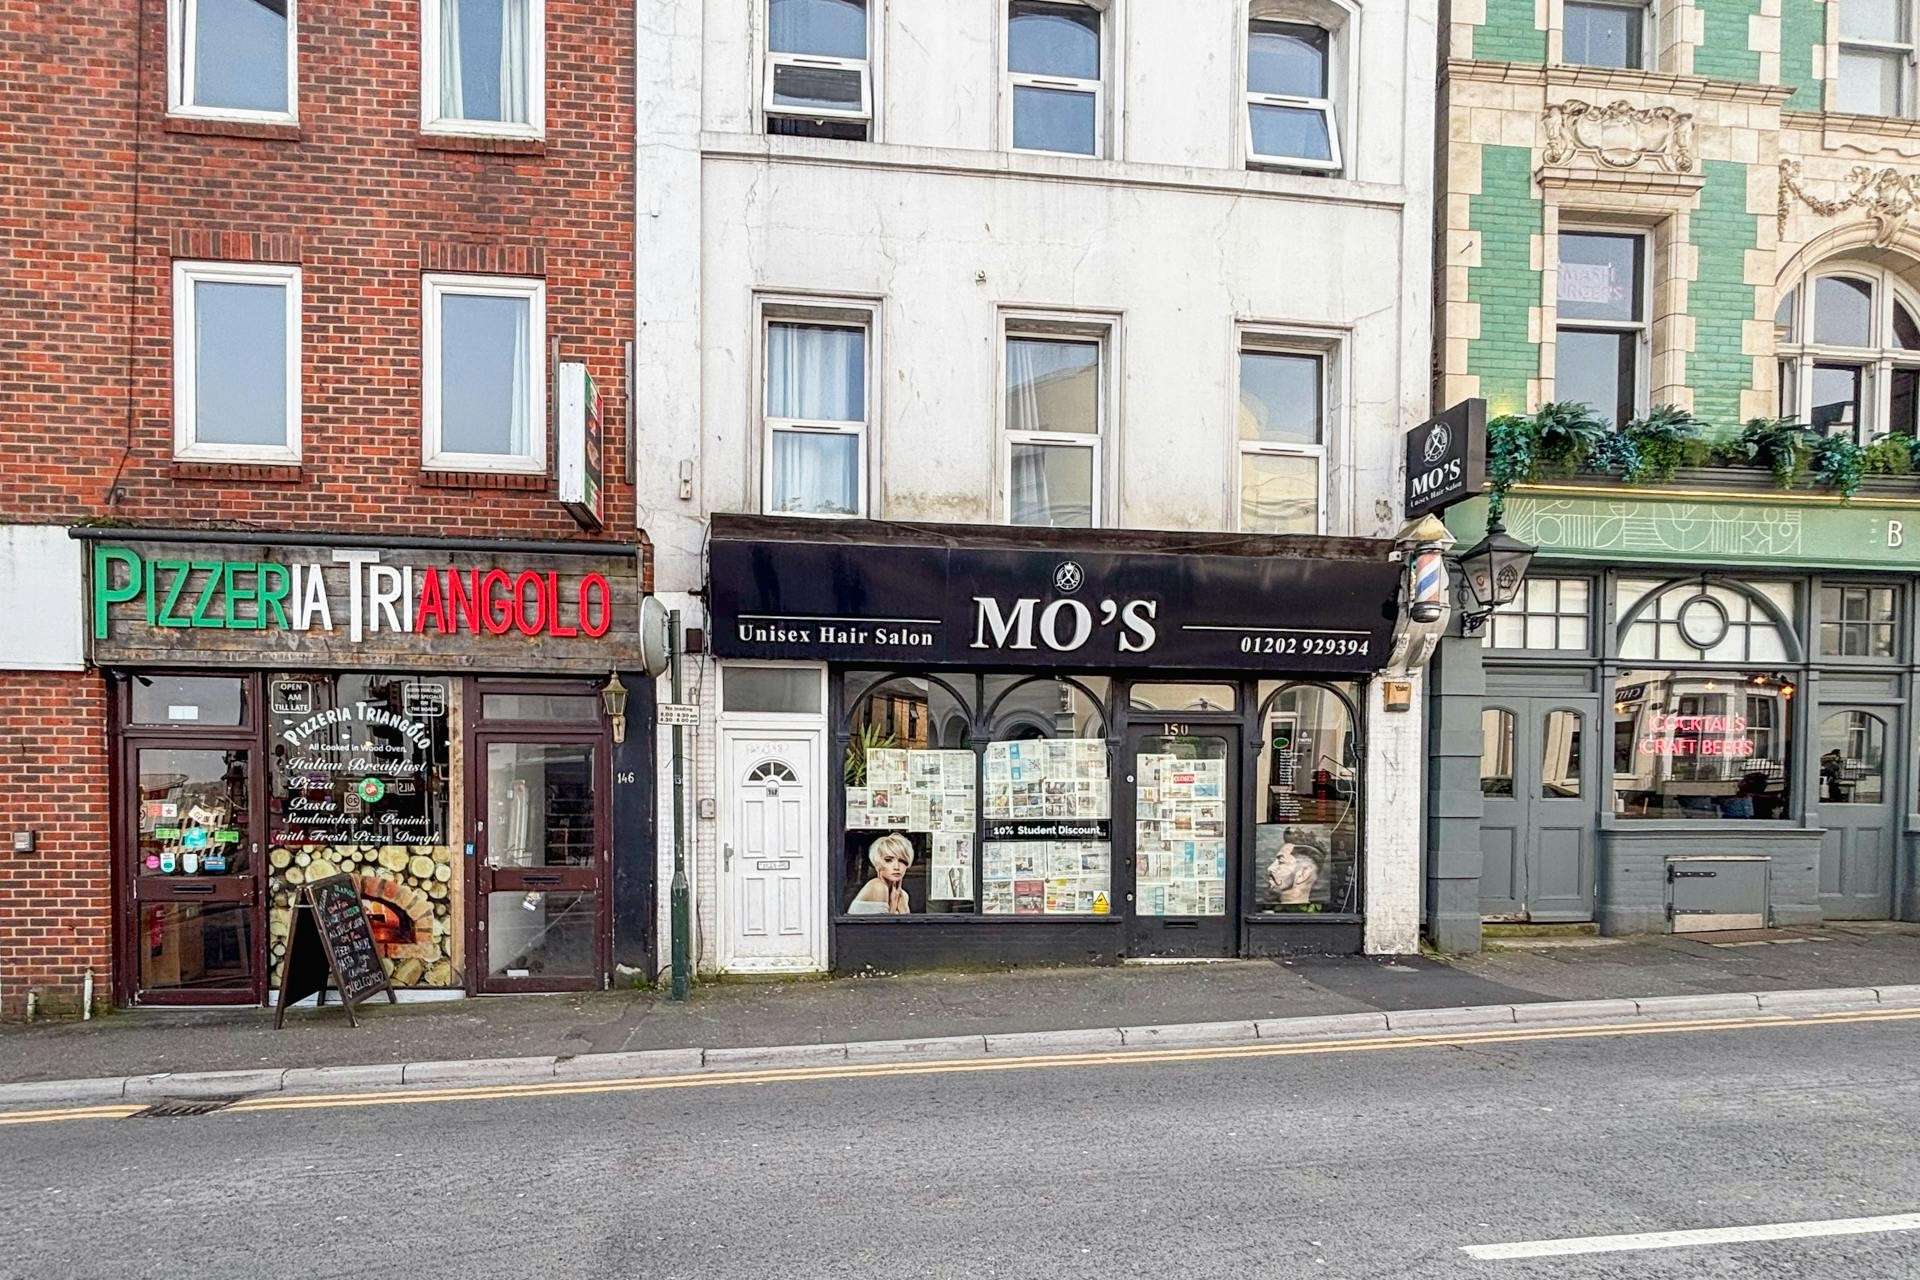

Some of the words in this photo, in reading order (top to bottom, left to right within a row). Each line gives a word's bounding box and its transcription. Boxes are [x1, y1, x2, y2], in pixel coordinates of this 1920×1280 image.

[1411, 458, 1461, 498] MO'S
[1887, 520, 1903, 547] B
[95, 546, 333, 639] PIZZERIA
[332, 550, 611, 642] TRIANGOLO
[970, 597, 1157, 652] MO'S
[738, 624, 810, 642] Unisex
[819, 626, 869, 644] Hair
[875, 628, 933, 645] Salon
[1240, 637, 1296, 654] 01202
[1302, 637, 1369, 656] 929394
[280, 683, 302, 691] OPEN
[283, 707, 351, 746] PIZZERIA
[355, 701, 431, 750] TRIANGOLO
[1162, 723, 1189, 736] 150
[1649, 714, 1747, 732] COCKTAILS
[321, 743, 349, 751] Cooked
[361, 744, 384, 752] Wood
[1639, 739, 1697, 755] CRAFT
[1701, 740, 1754, 757] BEERS
[286, 757, 342, 770] Italian
[348, 757, 427, 776] Breakfast
[288, 776, 336, 790] Pizza
[617, 772, 635, 784] 146
[288, 796, 337, 811] Pasta
[282, 813, 357, 825] Sandwiches
[362, 817, 374, 825] &
[379, 813, 431, 825] Paninis
[275, 830, 304, 841] with
[308, 830, 348, 841] Fresh
[353, 830, 392, 842] Pizza
[395, 830, 440, 845] Dough
[993, 826, 1014, 835] 10%
[1017, 826, 1057, 835] Student
